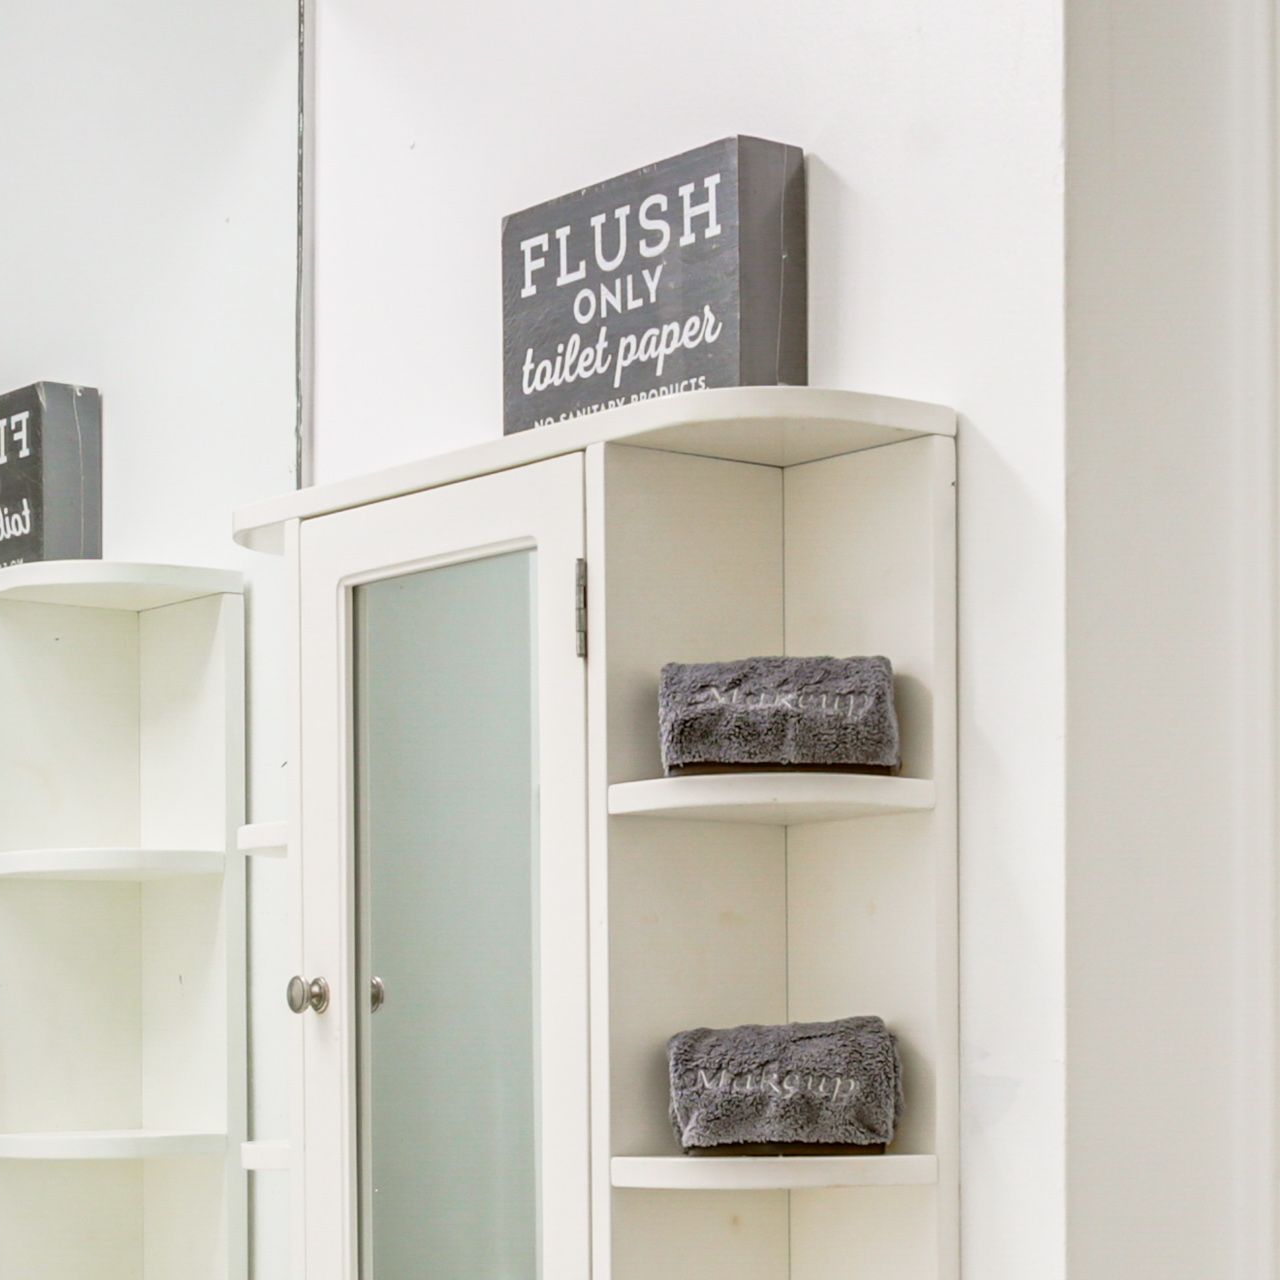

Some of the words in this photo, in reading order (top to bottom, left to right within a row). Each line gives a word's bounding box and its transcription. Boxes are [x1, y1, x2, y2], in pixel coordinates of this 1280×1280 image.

[520, 173, 721, 298] FLUSH
[573, 265, 664, 325] ONLY
[522, 326, 613, 395] toilet
[613, 305, 722, 388] paper
[694, 1066, 859, 1101] Makeup
